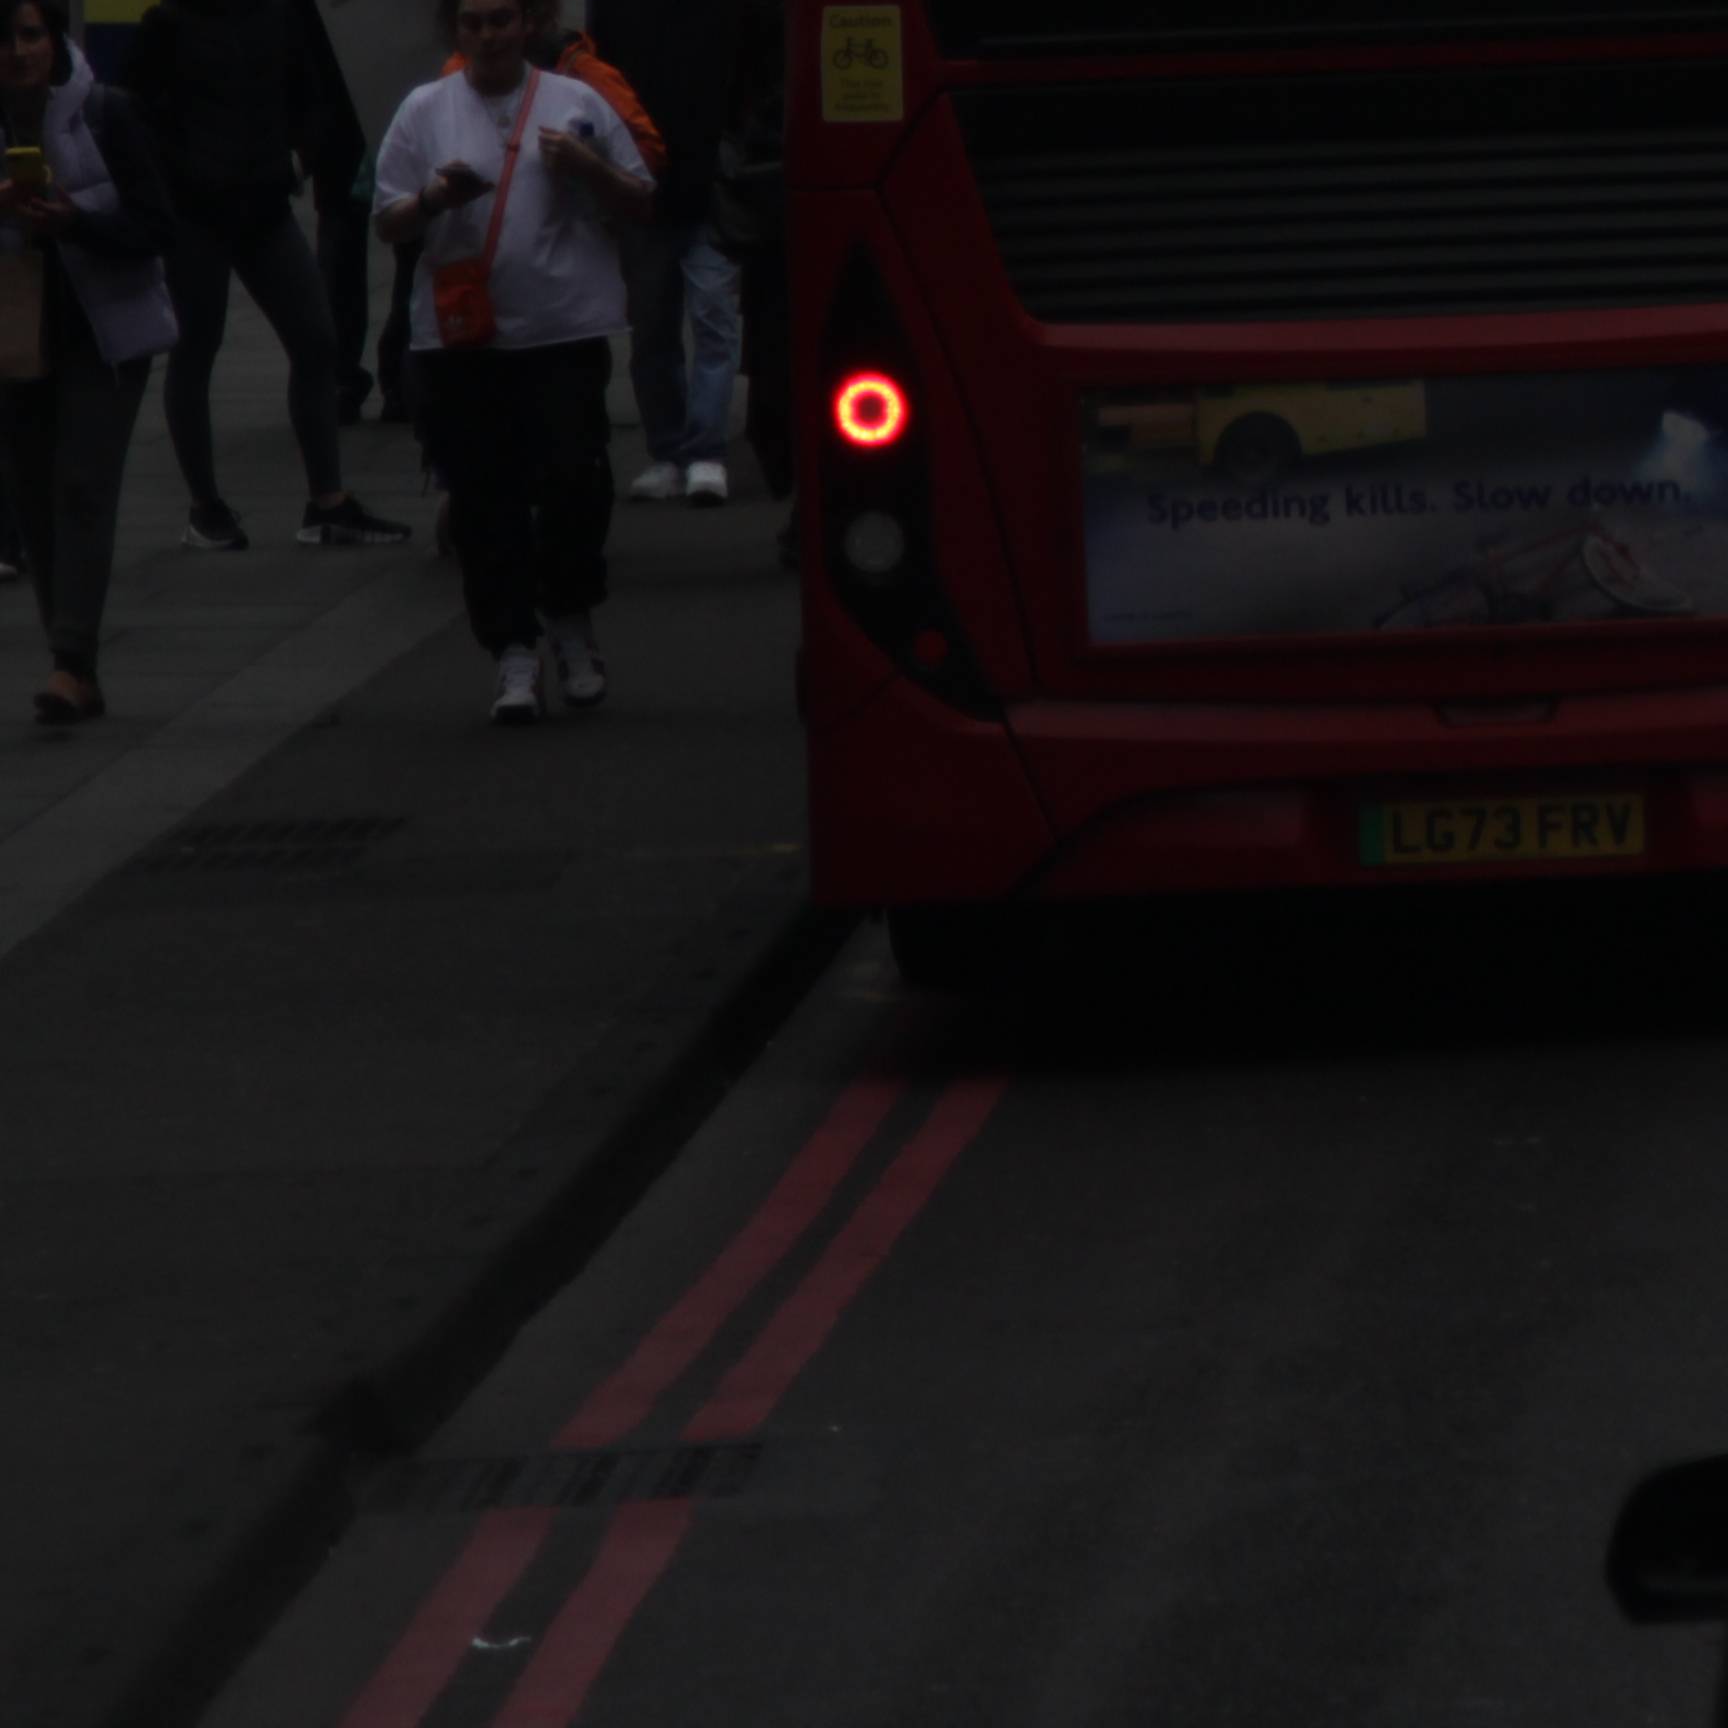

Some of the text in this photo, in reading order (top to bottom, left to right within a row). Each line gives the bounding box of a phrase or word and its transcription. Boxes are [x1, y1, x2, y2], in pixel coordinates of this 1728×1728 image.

[829, 14, 893, 30] Caution
[1147, 474, 1690, 533] Speeding kills. Slow down.
[1392, 801, 1632, 854] LG73 FRV
